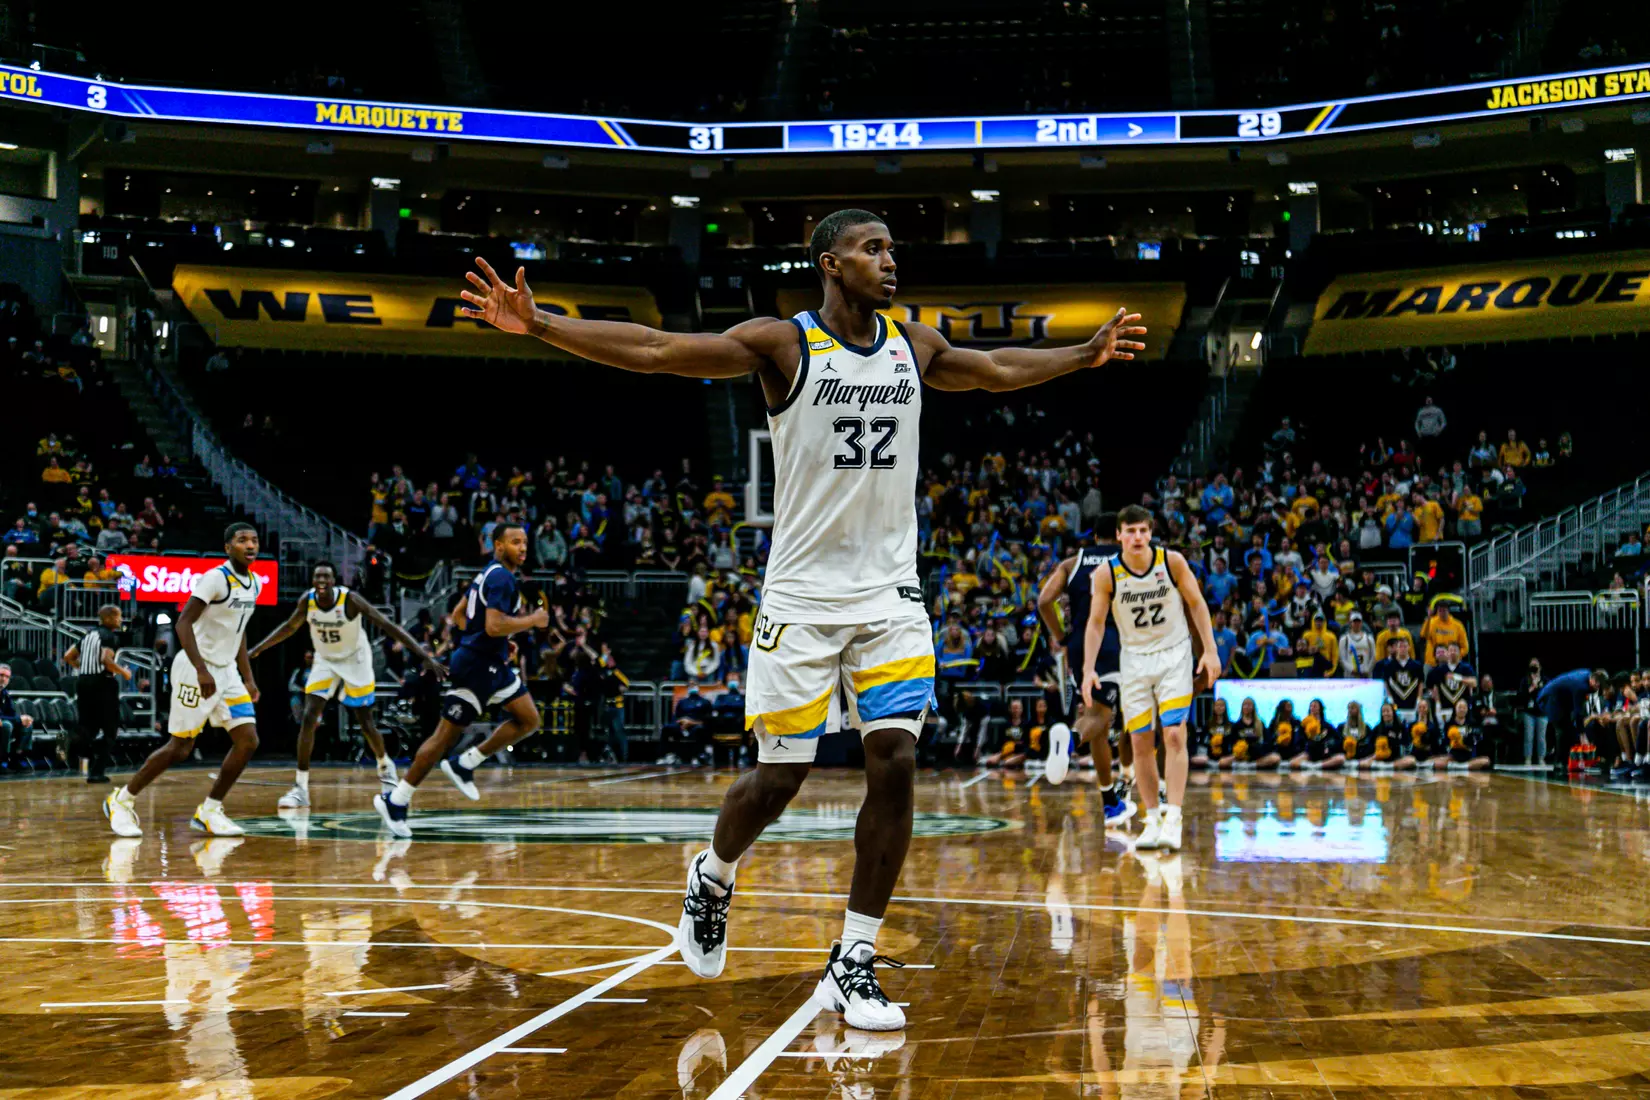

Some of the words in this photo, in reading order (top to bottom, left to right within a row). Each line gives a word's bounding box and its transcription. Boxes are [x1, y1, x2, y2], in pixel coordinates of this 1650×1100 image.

[87, 85, 107, 109] 3
[1487, 76, 1597, 109] JACKSON
[316, 103, 463, 132] MARQUETTE
[1036, 116, 1097, 142] 2nd
[1238, 112, 1282, 137] 29
[689, 127, 724, 150] 31
[829, 122, 923, 149] 19:44
[204, 288, 382, 325] WE
[812, 378, 915, 411] Marquette
[832, 416, 899, 469] 32
[142, 565, 204, 593] State
[1131, 603, 1166, 628] 22
[317, 629, 341, 643] 35
